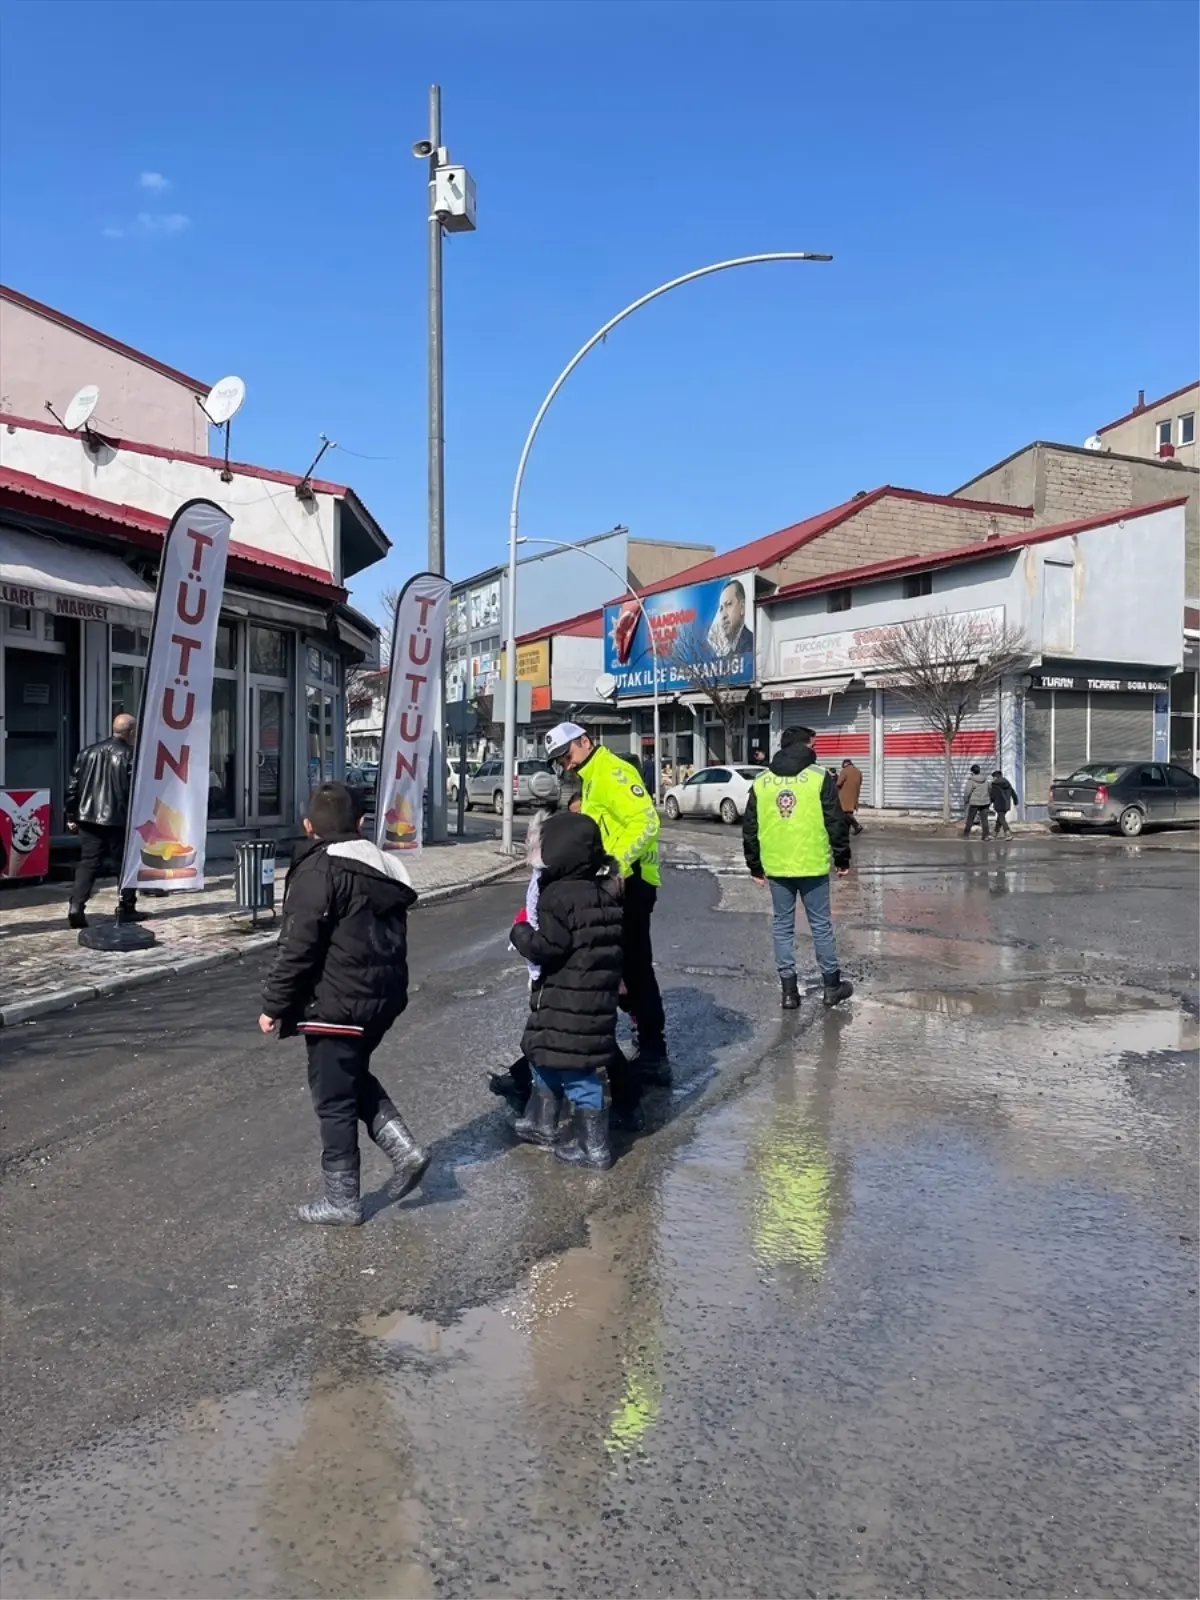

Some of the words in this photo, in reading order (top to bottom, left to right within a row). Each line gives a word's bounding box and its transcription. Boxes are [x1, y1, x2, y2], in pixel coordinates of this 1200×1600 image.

[56, 597, 109, 620] MARKET
[154, 528, 213, 784] TÜTÜN
[395, 596, 437, 781] TÜTÜN
[613, 671, 641, 689] UTAK
[1041, 676, 1074, 689] TURAN
